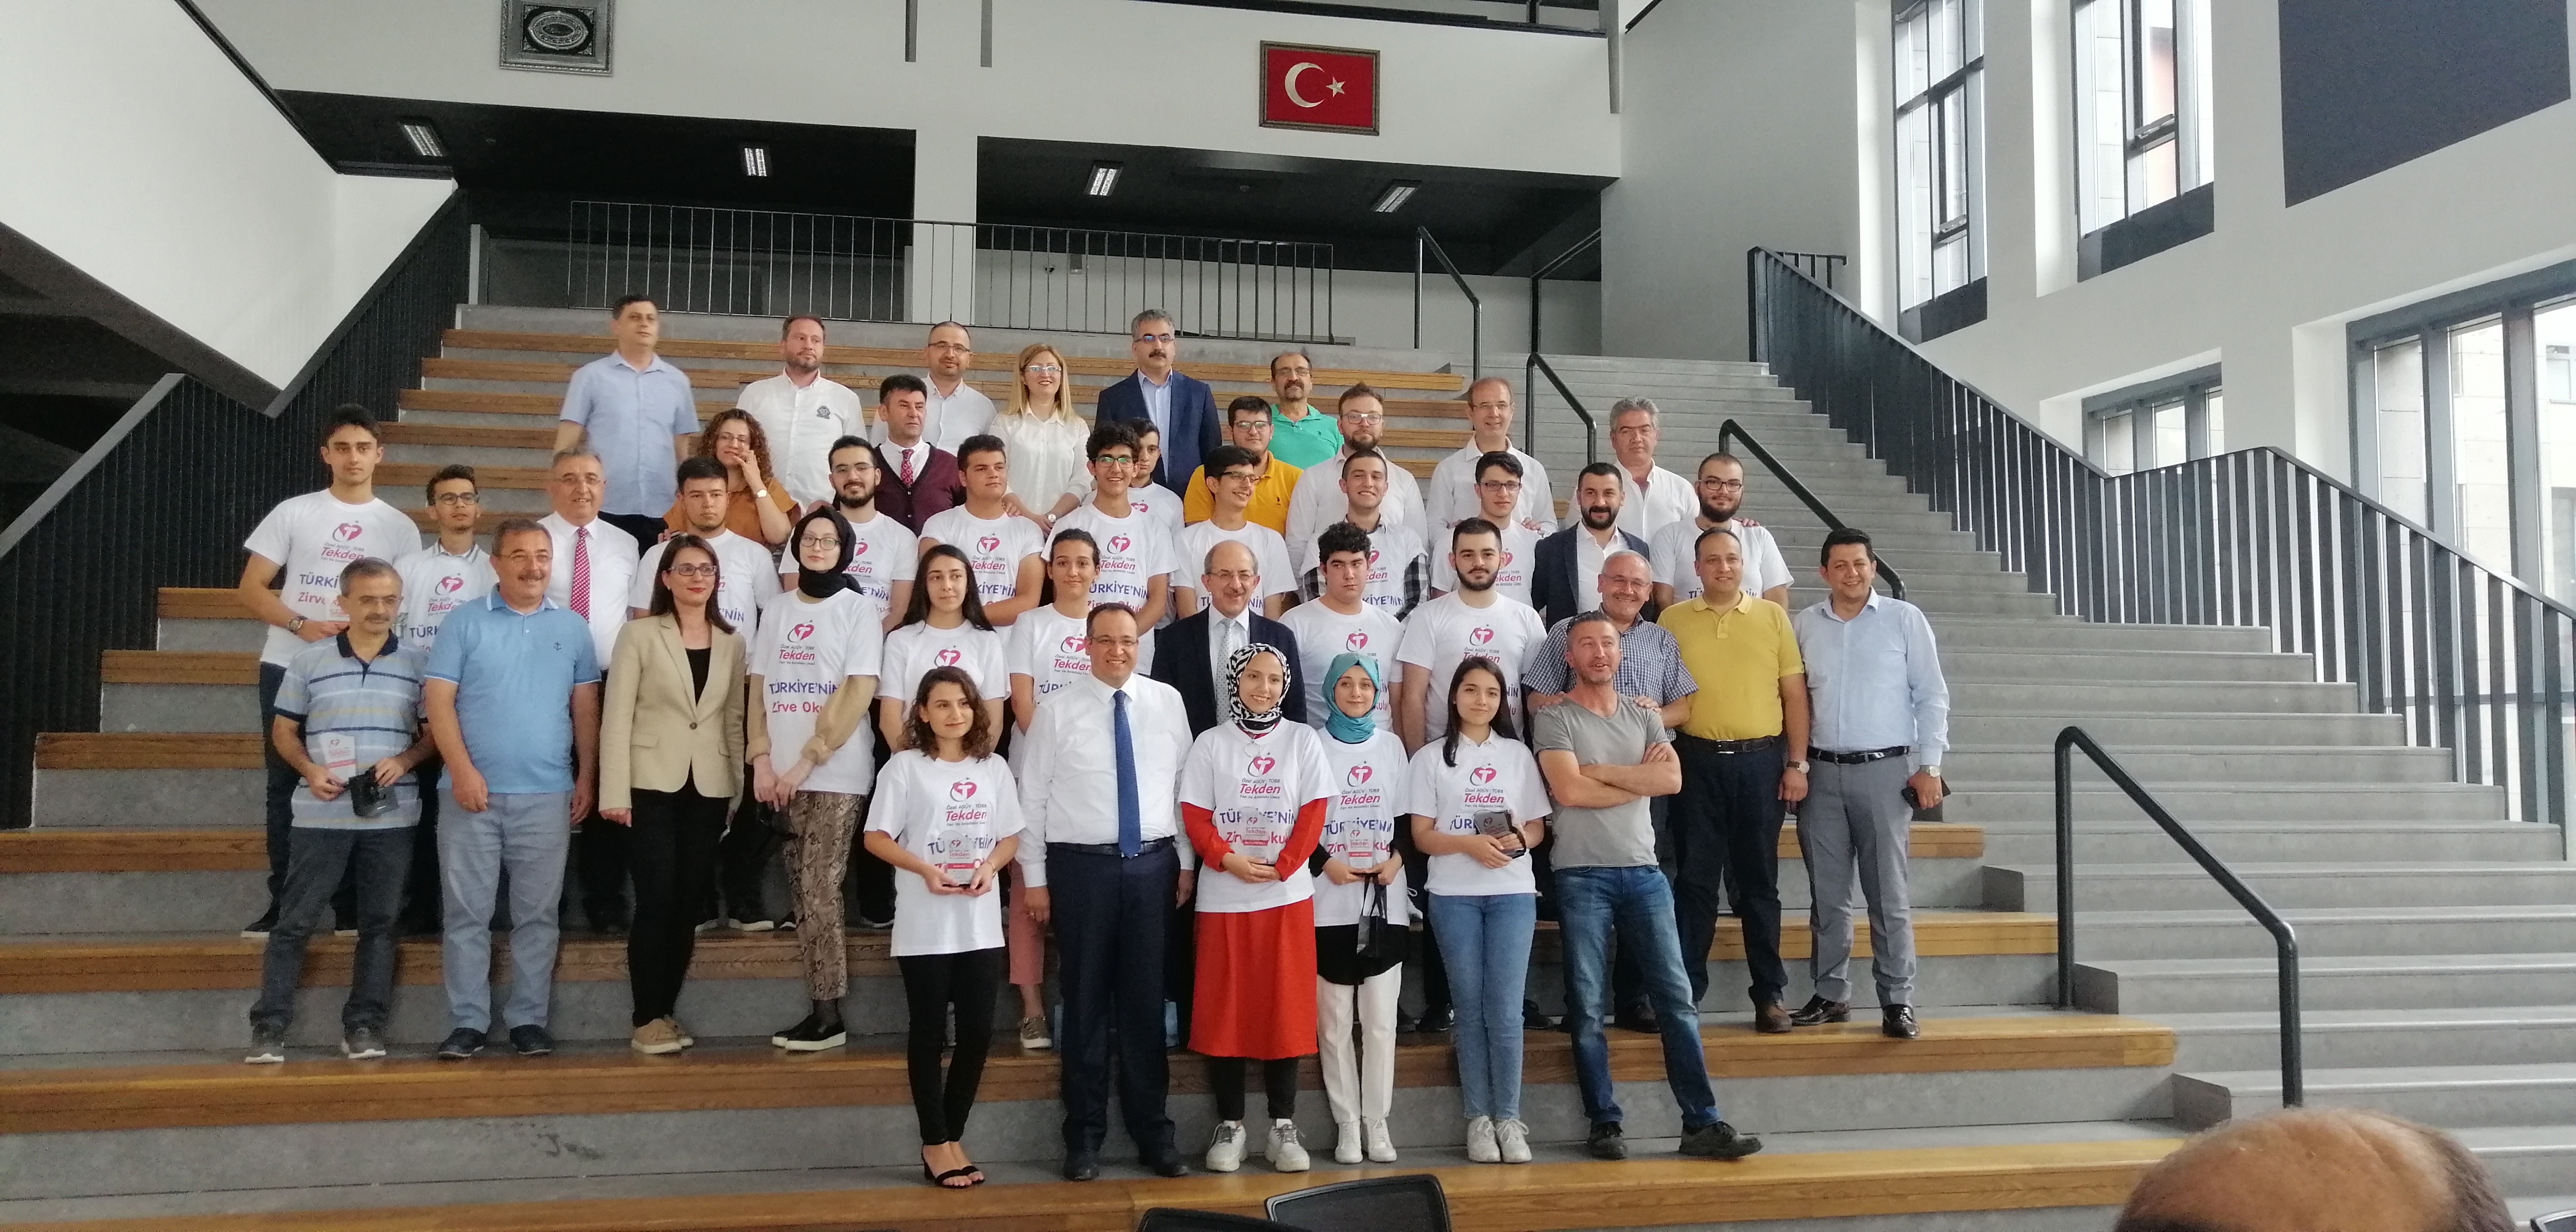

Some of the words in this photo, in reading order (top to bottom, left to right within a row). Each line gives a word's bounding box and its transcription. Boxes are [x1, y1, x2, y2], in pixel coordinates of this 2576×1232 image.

[1101, 560, 1136, 570] Tekden
[1495, 574, 1521, 582] ekden
[779, 649, 815, 661] Tekden
[1240, 783, 1281, 795] Tekden
[1340, 794, 1381, 806] Tekden
[1464, 793, 1505, 804] Tekden
[946, 809, 987, 822] Tekden
